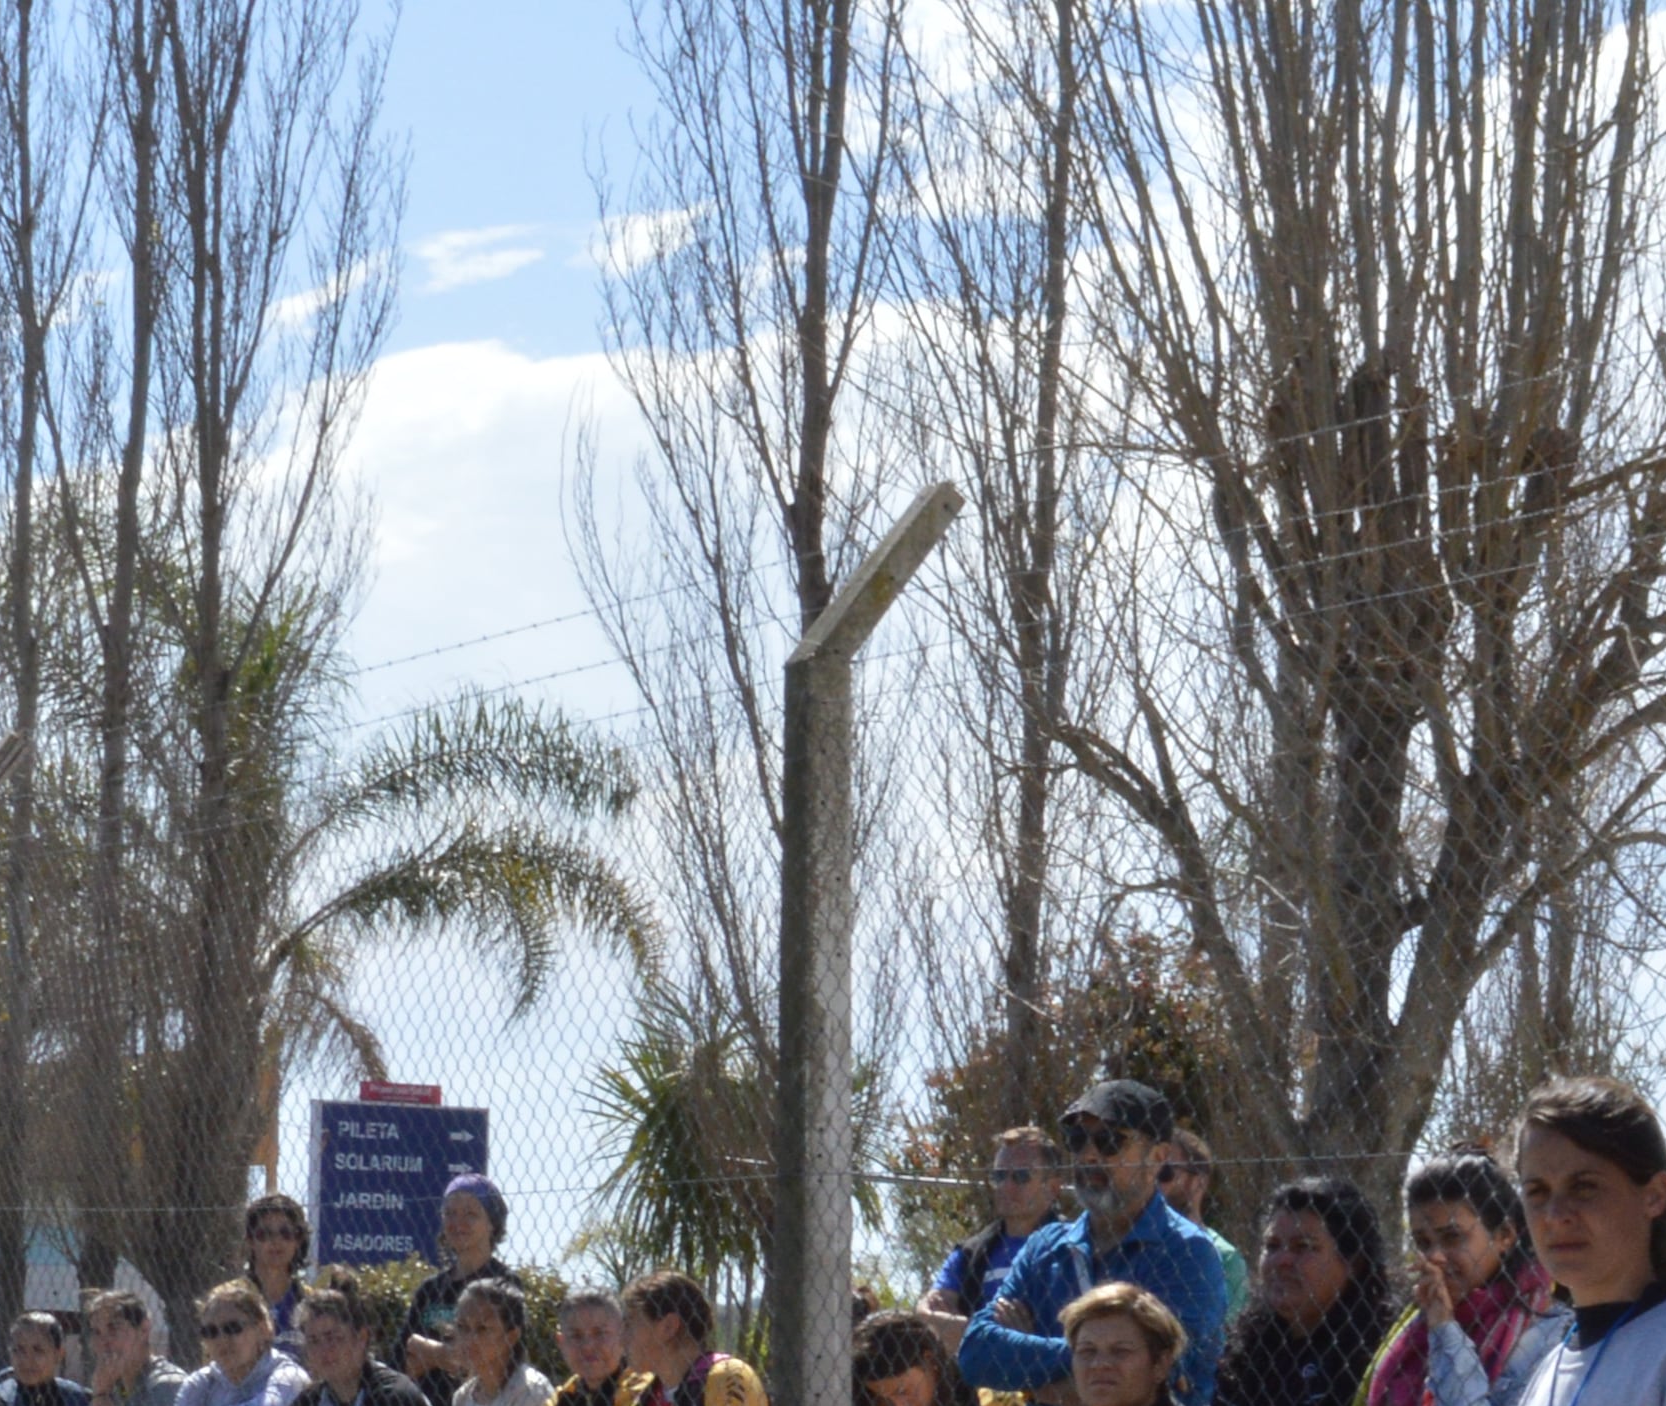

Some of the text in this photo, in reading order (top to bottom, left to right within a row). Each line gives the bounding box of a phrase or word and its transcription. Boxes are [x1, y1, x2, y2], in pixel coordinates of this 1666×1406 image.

[337, 1120, 400, 1140] PILETA
[334, 1152, 423, 1173] SOLARIUM
[333, 1190, 404, 1211] JARDÍN
[333, 1232, 414, 1252] ASADORES
